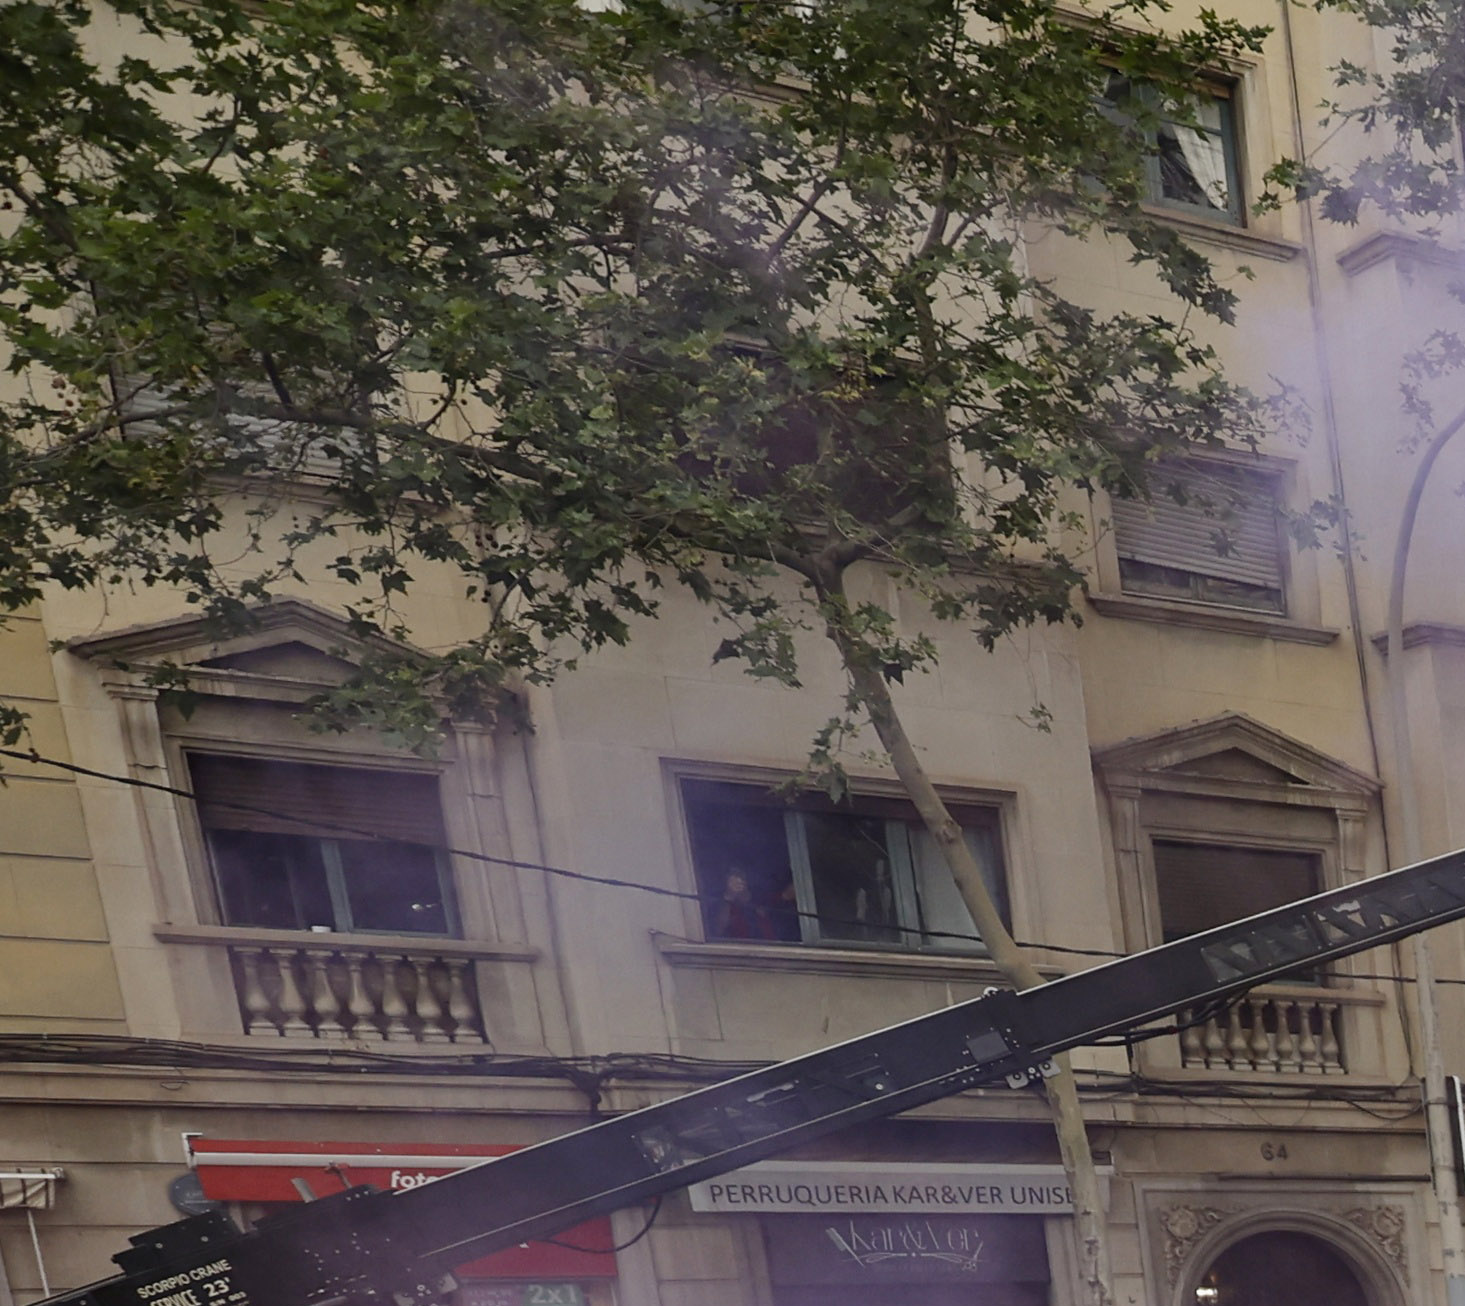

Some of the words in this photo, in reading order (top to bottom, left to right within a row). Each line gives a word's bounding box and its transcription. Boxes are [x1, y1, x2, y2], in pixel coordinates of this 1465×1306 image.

[1261, 1143, 1288, 1161] 64
[709, 1184, 890, 1207] PERRUQUERIA
[893, 1184, 1004, 1205] KAR&VER
[137, 1273, 190, 1298] SCORPIO
[189, 1259, 232, 1281] CRANE
